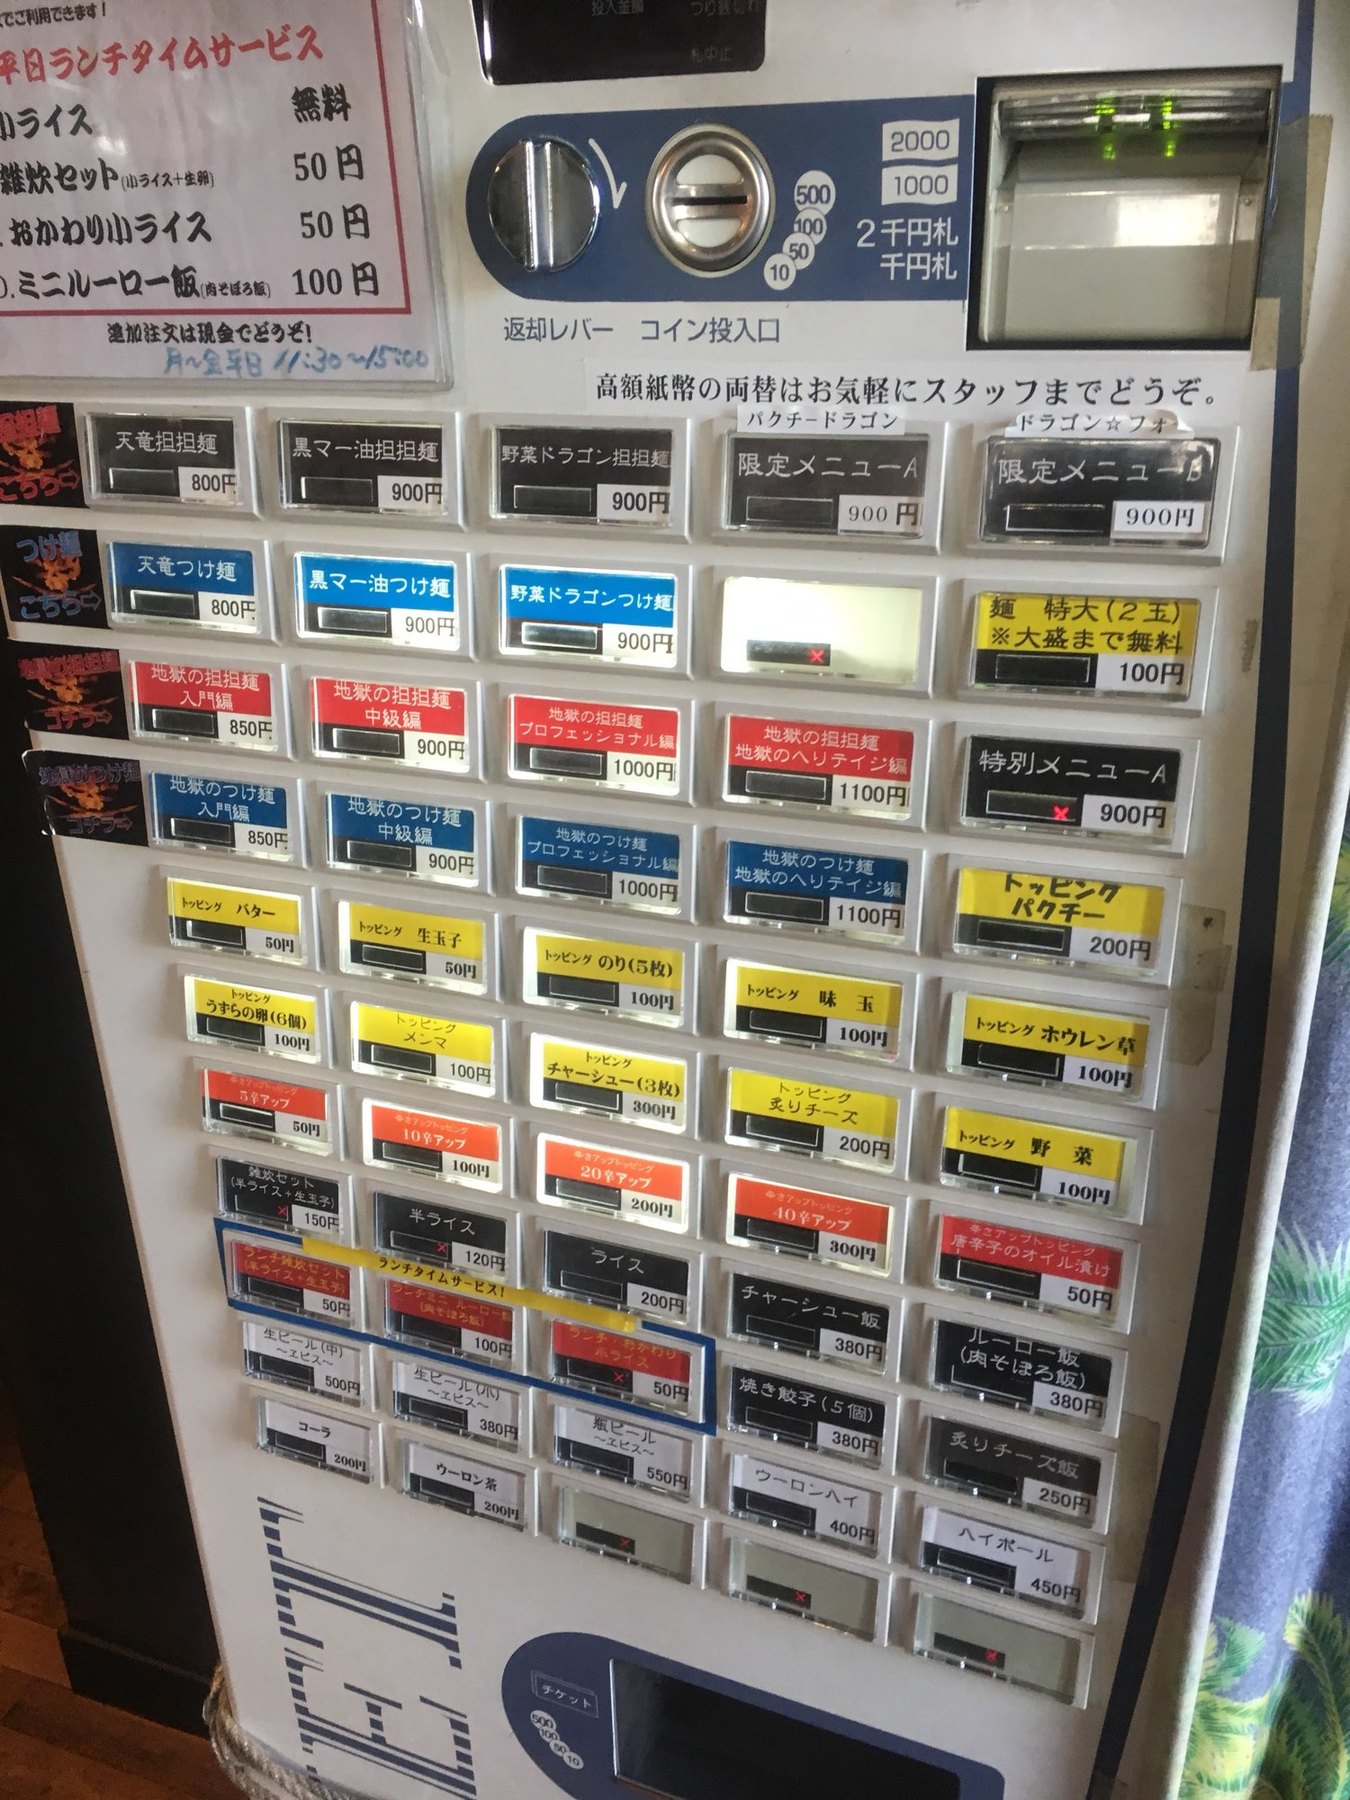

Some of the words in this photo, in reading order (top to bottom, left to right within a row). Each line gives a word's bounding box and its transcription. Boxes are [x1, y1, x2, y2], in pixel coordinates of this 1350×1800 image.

[0, 24, 324, 85] 平日ランチタイムサービス
[291, 83, 352, 124] 無料
[890, 129, 951, 152] 2000
[293, 143, 365, 183] 50円
[796, 184, 831, 205] 500
[894, 174, 949, 196] 1000
[299, 203, 371, 239] 50円
[794, 218, 824, 236] 100
[856, 216, 959, 248] 2千円札
[788, 243, 810, 260] 50
[769, 263, 790, 282] 10
[879, 251, 958, 281] 千円札
[291, 261, 380, 297] 100円
[107, 320, 314, 345] 追加注文は現金でどうぞ!
[503, 316, 614, 342] 返却レバー
[640, 316, 781, 343] コイン投入口
[595, 372, 1216, 407] 高額紙幣の両替はお気軽にスタッフまでどうぞ。
[746, 411, 899, 431] パクチードラゴン
[115, 430, 219, 456] 天竜担担麺
[292, 437, 439, 464] 黒マー油担担麺
[501, 445, 672, 469] 野菜ドラゴン担担麺
[738, 451, 920, 480] 限定メニューA
[191, 473, 237, 495] 800円
[391, 481, 443, 504] 900円
[612, 491, 671, 514] 900円
[847, 501, 922, 527] 900円
[1126, 505, 1196, 528] 900円
[137, 555, 237, 582] 天竜つけ麺
[309, 569, 453, 599] 黒マー油つけ麺
[211, 599, 256, 621] 800円
[510, 583, 674, 612] 野菜ドラゴンつけ麺
[405, 615, 455, 638] 900円
[1045, 601, 1182, 627] 特大(2玉)
[617, 631, 673, 655] 900円
[150, 663, 260, 693] 地獄の担担麺
[1119, 660, 1186, 686] 100円
[180, 690, 234, 712] 入門編
[333, 680, 452, 710] 地獄の担担麺
[229, 720, 273, 740] 850円
[364, 709, 422, 730] 中級編
[548, 706, 644, 730] 地獄の担担麺
[519, 721, 676, 751] プロフェッショナル編
[763, 725, 880, 752] 地獄の担担麺
[417, 739, 466, 760] 900円
[613, 758, 675, 782] 1000円
[978, 749, 1167, 784] 特別メニューA
[169, 775, 276, 805] 地獄のつけ麺
[839, 781, 908, 807] 1100円
[197, 801, 250, 822] 入門編
[348, 797, 463, 828] 地獄のつけ麺
[1100, 803, 1167, 830] 900円
[247, 831, 289, 851] 850円
[377, 824, 433, 846] 中級編
[555, 827, 649, 852] 地獄のつけ麺
[428, 853, 475, 876] 900円
[527, 840, 680, 871] プロフェッショナル編
[761, 849, 876, 876] 地獄のつけ麺
[618, 878, 678, 902] 1000円
[181, 896, 223, 914] トッピング
[236, 902, 276, 919] バター
[836, 903, 903, 929] 1100円
[1010, 897, 1106, 922] パクチー
[265, 936, 295, 954] 50円
[358, 919, 403, 938] トッピング
[416, 927, 463, 950] 生玉子
[1088, 936, 1152, 961] 200円
[444, 961, 477, 980] 50円
[544, 949, 592, 966] トッピング
[598, 955, 673, 979] のり(5枚)
[230, 988, 271, 1005] トッピング
[630, 990, 675, 1011] 100円
[746, 983, 799, 1002] トッピング
[206, 1000, 307, 1030] うずらの卵(6個)
[273, 1033, 311, 1052] 100円
[403, 1032, 447, 1050] メンマ
[839, 1025, 889, 1048] 100円
[976, 1016, 1034, 1037] トッピング
[1040, 1024, 1136, 1056] ホウレン草
[584, 1051, 632, 1068] トッピング
[450, 1062, 491, 1083] 100円
[547, 1062, 682, 1099] チャーシュー(3枚)
[1078, 1065, 1133, 1089] 100円
[778, 1082, 853, 1103] トッピング
[632, 1099, 676, 1121] 300円
[768, 1095, 858, 1125] 炙りチーズ
[292, 1120, 321, 1138] 50円
[402, 1128, 467, 1150] 10辛アップ
[958, 1130, 1016, 1151] トッピング
[839, 1136, 891, 1160] 200円
[452, 1159, 491, 1179] 100円
[580, 1164, 653, 1190] 20辛アップ
[1057, 1181, 1111, 1205] 100円
[630, 1196, 674, 1219] 200円
[771, 1206, 853, 1233] 40辛アップ
[408, 1207, 477, 1236] 半ライス
[465, 1250, 506, 1273] 120円
[591, 1249, 645, 1275] ライス
[829, 1239, 877, 1263] 300円
[950, 1233, 1111, 1277] 唐辛子のオイル漬け
[378, 1256, 505, 1298] ランチタイムサービス!
[641, 1290, 686, 1316] 200円
[742, 1284, 883, 1331] チャーシュー飯
[1067, 1285, 1114, 1312] 50円
[263, 1327, 344, 1359] 生ビール(中)
[474, 1336, 513, 1359] 100円
[834, 1337, 884, 1363] 380円
[968, 1327, 1081, 1369] ルーロー飯
[960, 1345, 1086, 1392] (肉そぼろ飯)
[325, 1375, 361, 1396] 500円
[653, 1381, 690, 1402] 50円
[739, 1376, 874, 1425] 焼き餃子(5個)
[1049, 1391, 1104, 1418] 380円
[298, 1421, 331, 1439] コーラ
[479, 1418, 519, 1440] 380円
[592, 1415, 657, 1445] 瓶ビール
[831, 1430, 879, 1456] 380円
[950, 1431, 1080, 1480] 炙りチーズ飯
[334, 1453, 367, 1473] 200円
[435, 1463, 498, 1492] ウーロン茶
[646, 1466, 690, 1491] 550円
[483, 1500, 519, 1522] 200円
[1039, 1486, 1091, 1515] 250円
[830, 1520, 876, 1545] 400円
[957, 1526, 1055, 1563] ハイボール
[1030, 1577, 1081, 1603] 450円
[541, 1683, 592, 1709] チケット
[567, 1755, 581, 1767] 10
